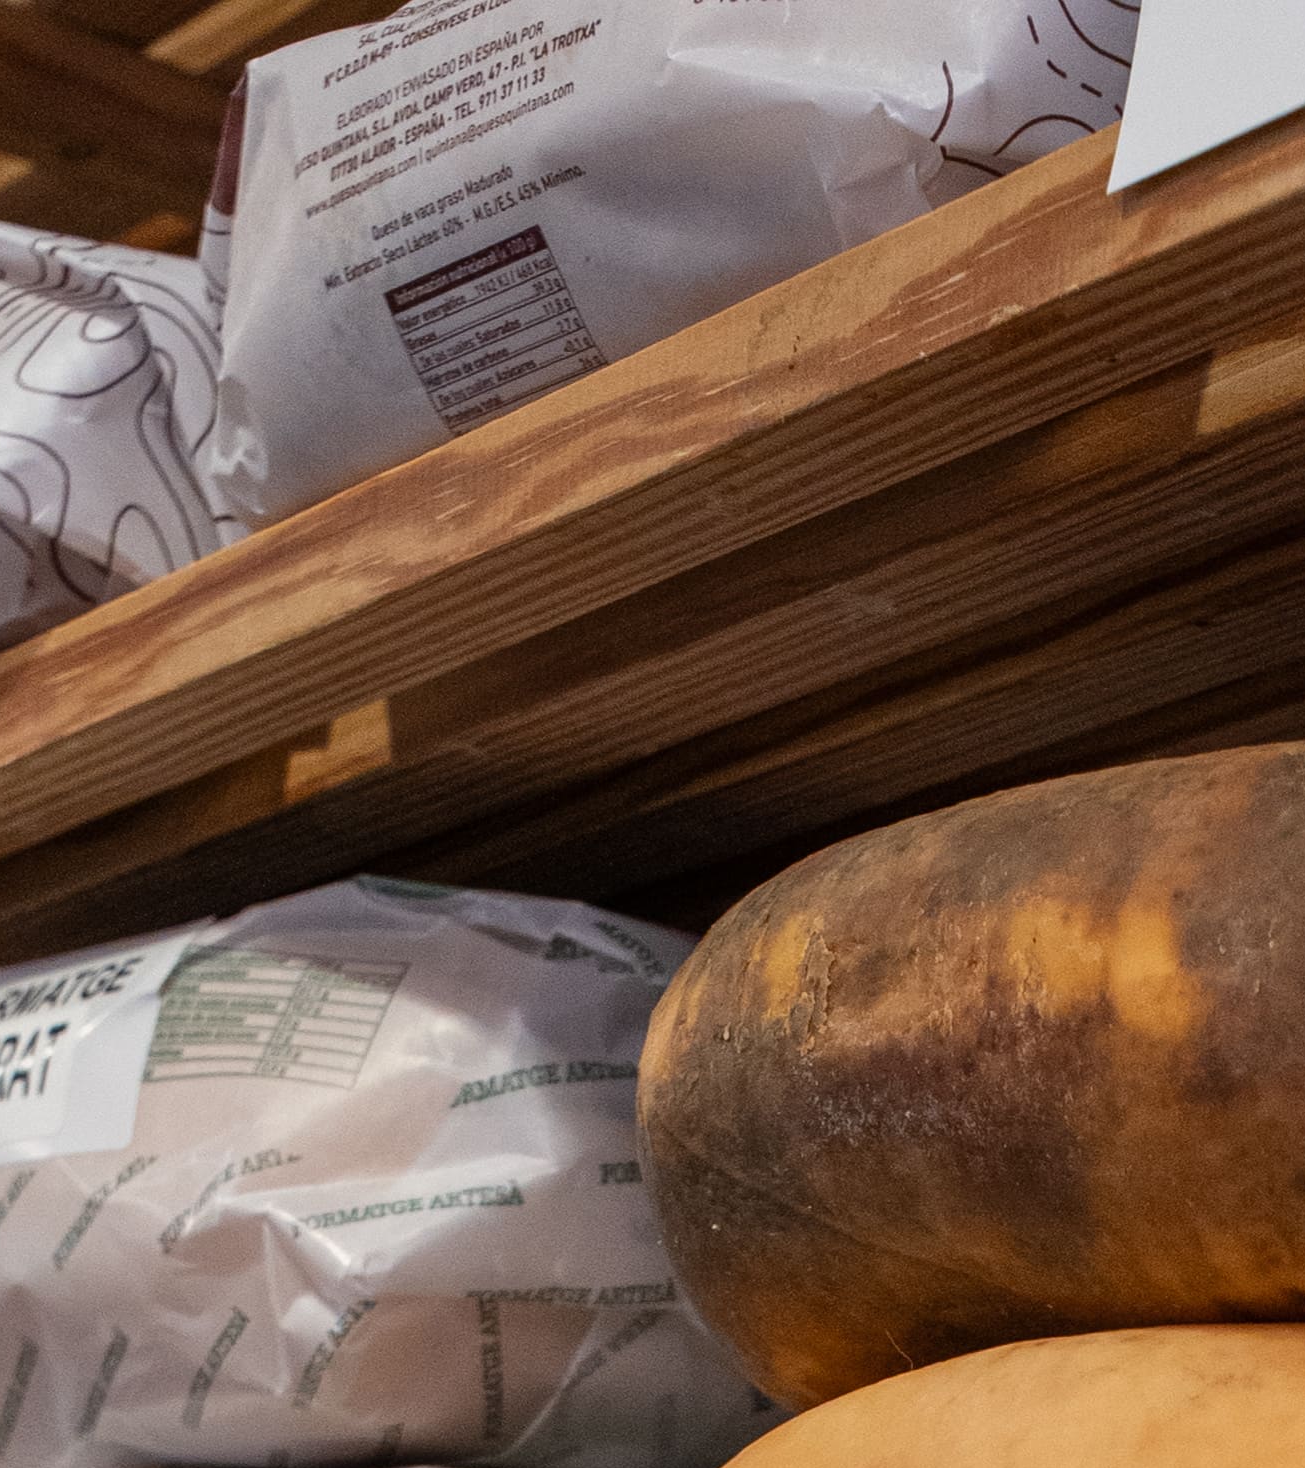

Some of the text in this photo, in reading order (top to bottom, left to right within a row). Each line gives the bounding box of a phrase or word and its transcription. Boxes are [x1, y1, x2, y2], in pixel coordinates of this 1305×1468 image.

[402, 58, 456, 98] ENVASADO
[458, 49, 473, 71] EN
[475, 27, 517, 63] ESPAÑA
[521, 18, 544, 43] POR
[423, 83, 453, 112] CAMP
[488, 61, 501, 82] 47
[404, 108, 446, 146] ESPAÑA
[478, 87, 496, 111] 971
[500, 79, 514, 100] 37
[520, 72, 530, 92] 11
[533, 64, 547, 86] 33
